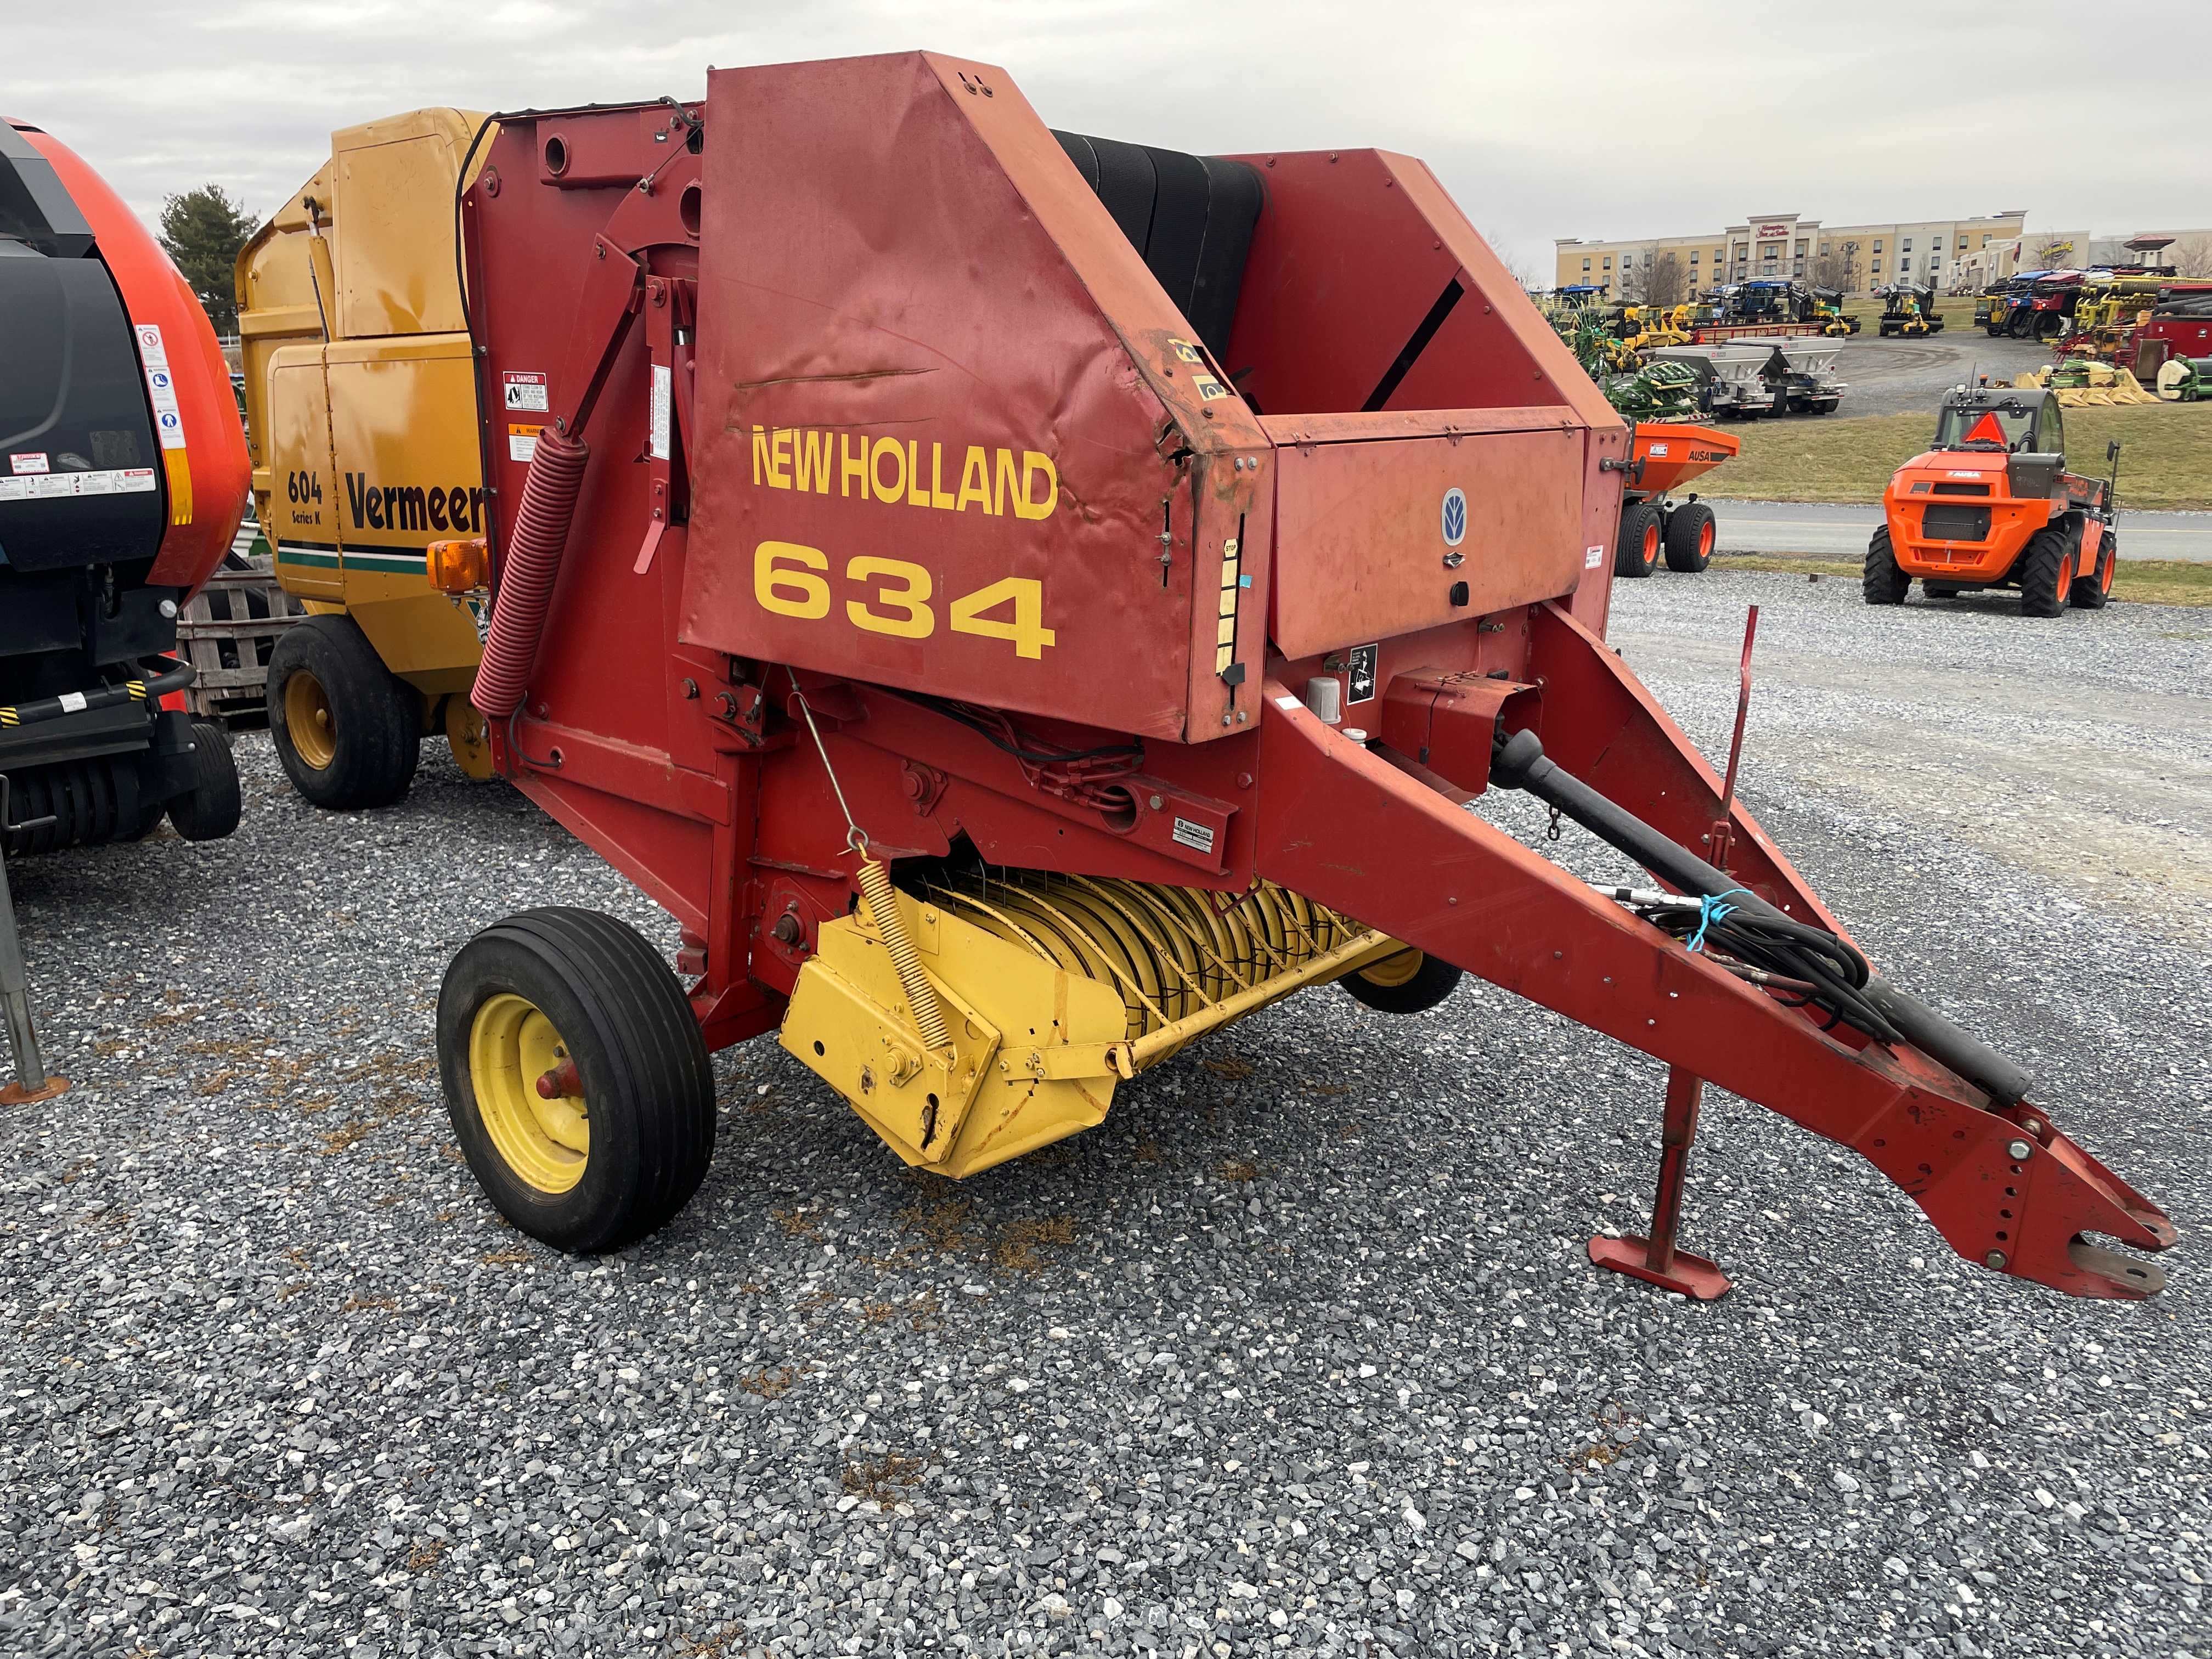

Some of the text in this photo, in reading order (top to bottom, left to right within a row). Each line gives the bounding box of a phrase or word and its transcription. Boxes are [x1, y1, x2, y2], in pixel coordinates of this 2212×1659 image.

[516, 375, 538, 383] DANGER
[1688, 451, 1710, 461] AUSA
[753, 425, 1058, 521] NEW HOLLAND
[288, 470, 322, 505] 604
[345, 472, 484, 533] Vermeer
[292, 510, 321, 525] Series K
[754, 540, 1056, 660] 634
[1193, 828, 1210, 838] HOLLAND
